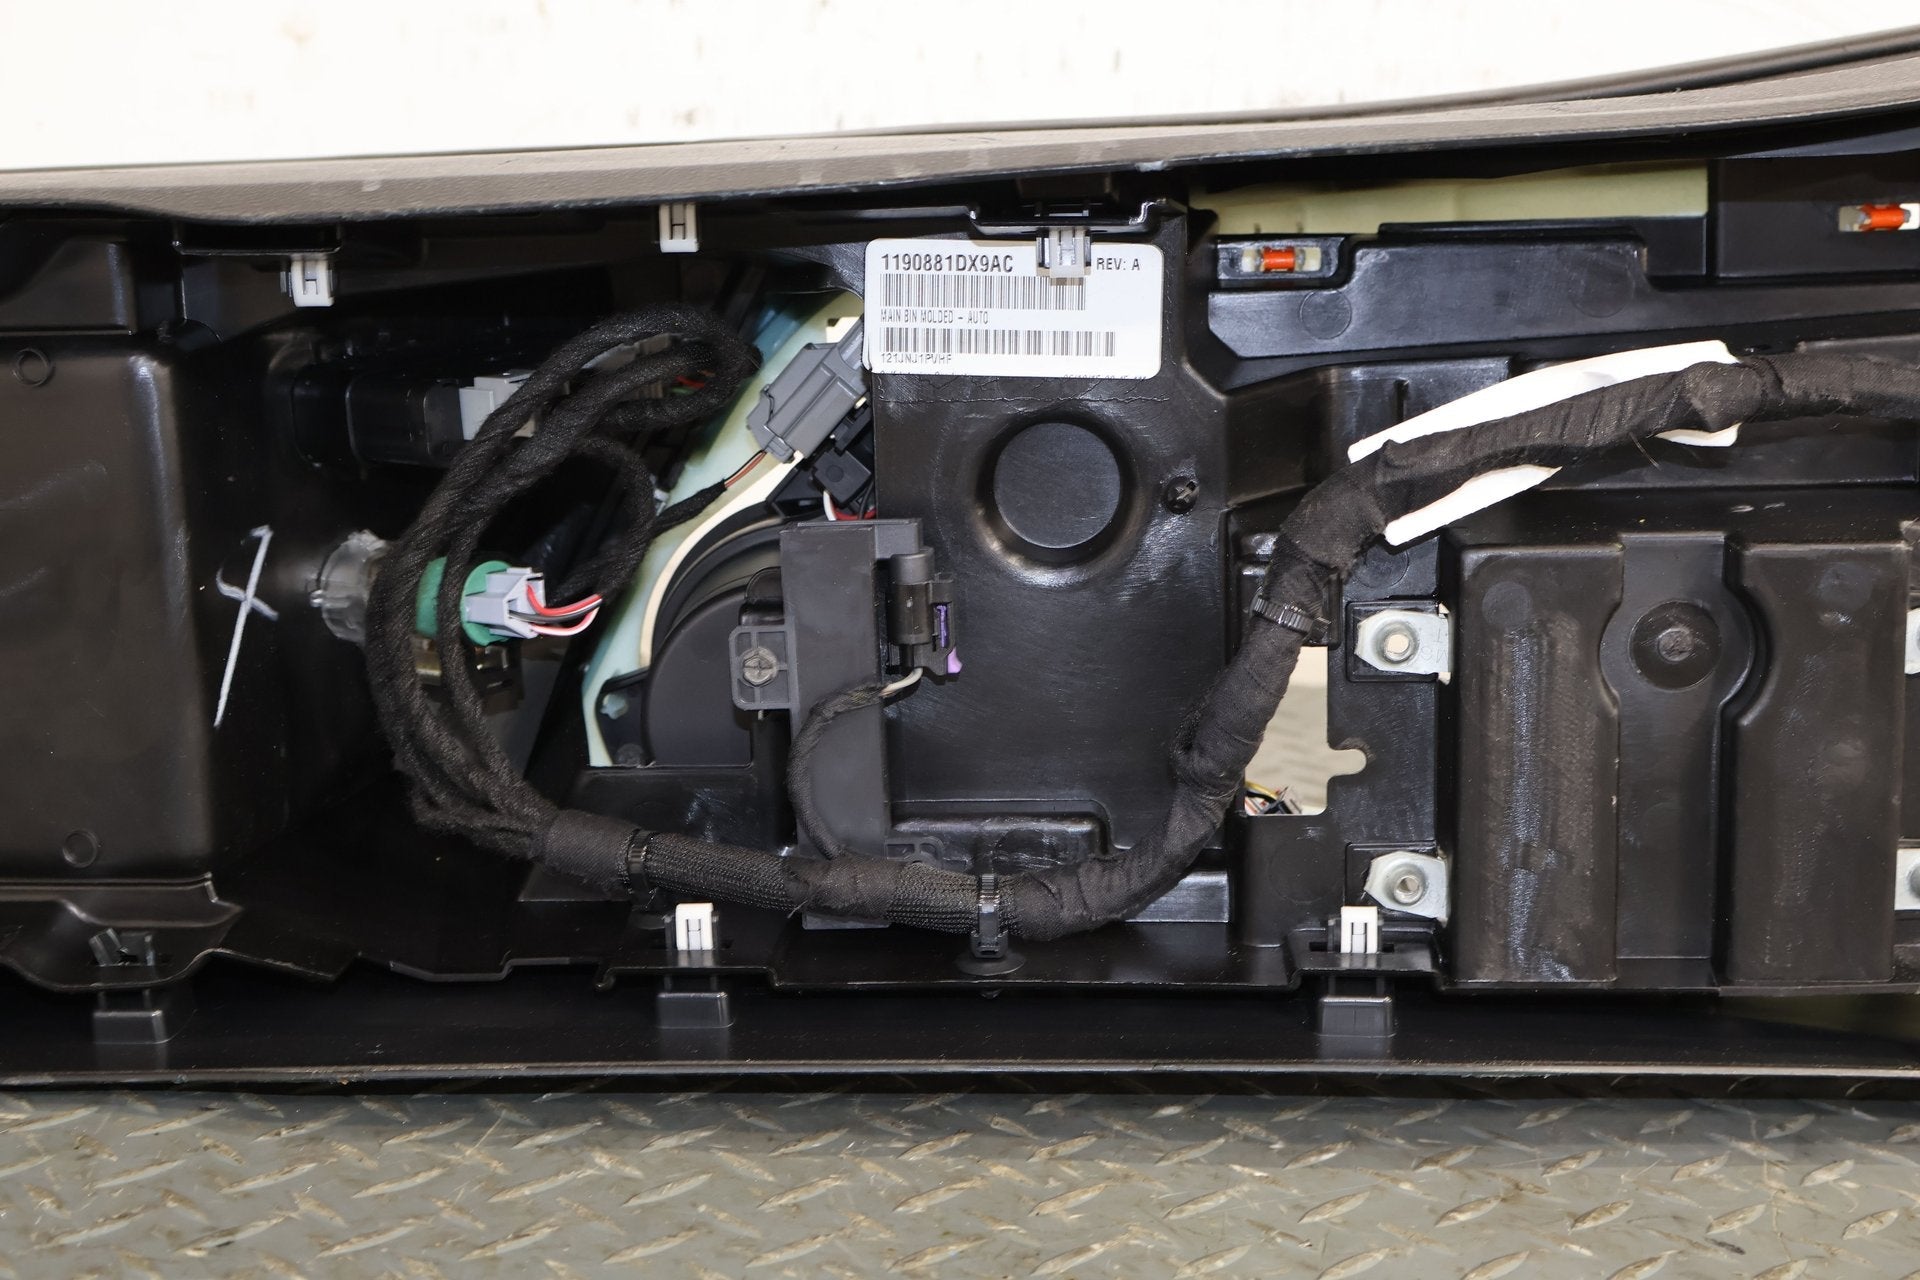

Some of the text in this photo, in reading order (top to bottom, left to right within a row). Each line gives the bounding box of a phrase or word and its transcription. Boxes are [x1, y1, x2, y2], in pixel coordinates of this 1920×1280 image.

[881, 253, 1014, 273] 1190881DX9AC
[1096, 257, 1141, 271] REV: A
[880, 309, 901, 323] MAIN
[904, 309, 918, 323] BIN
[920, 310, 954, 324] MOLDED
[967, 312, 989, 325] AUTO
